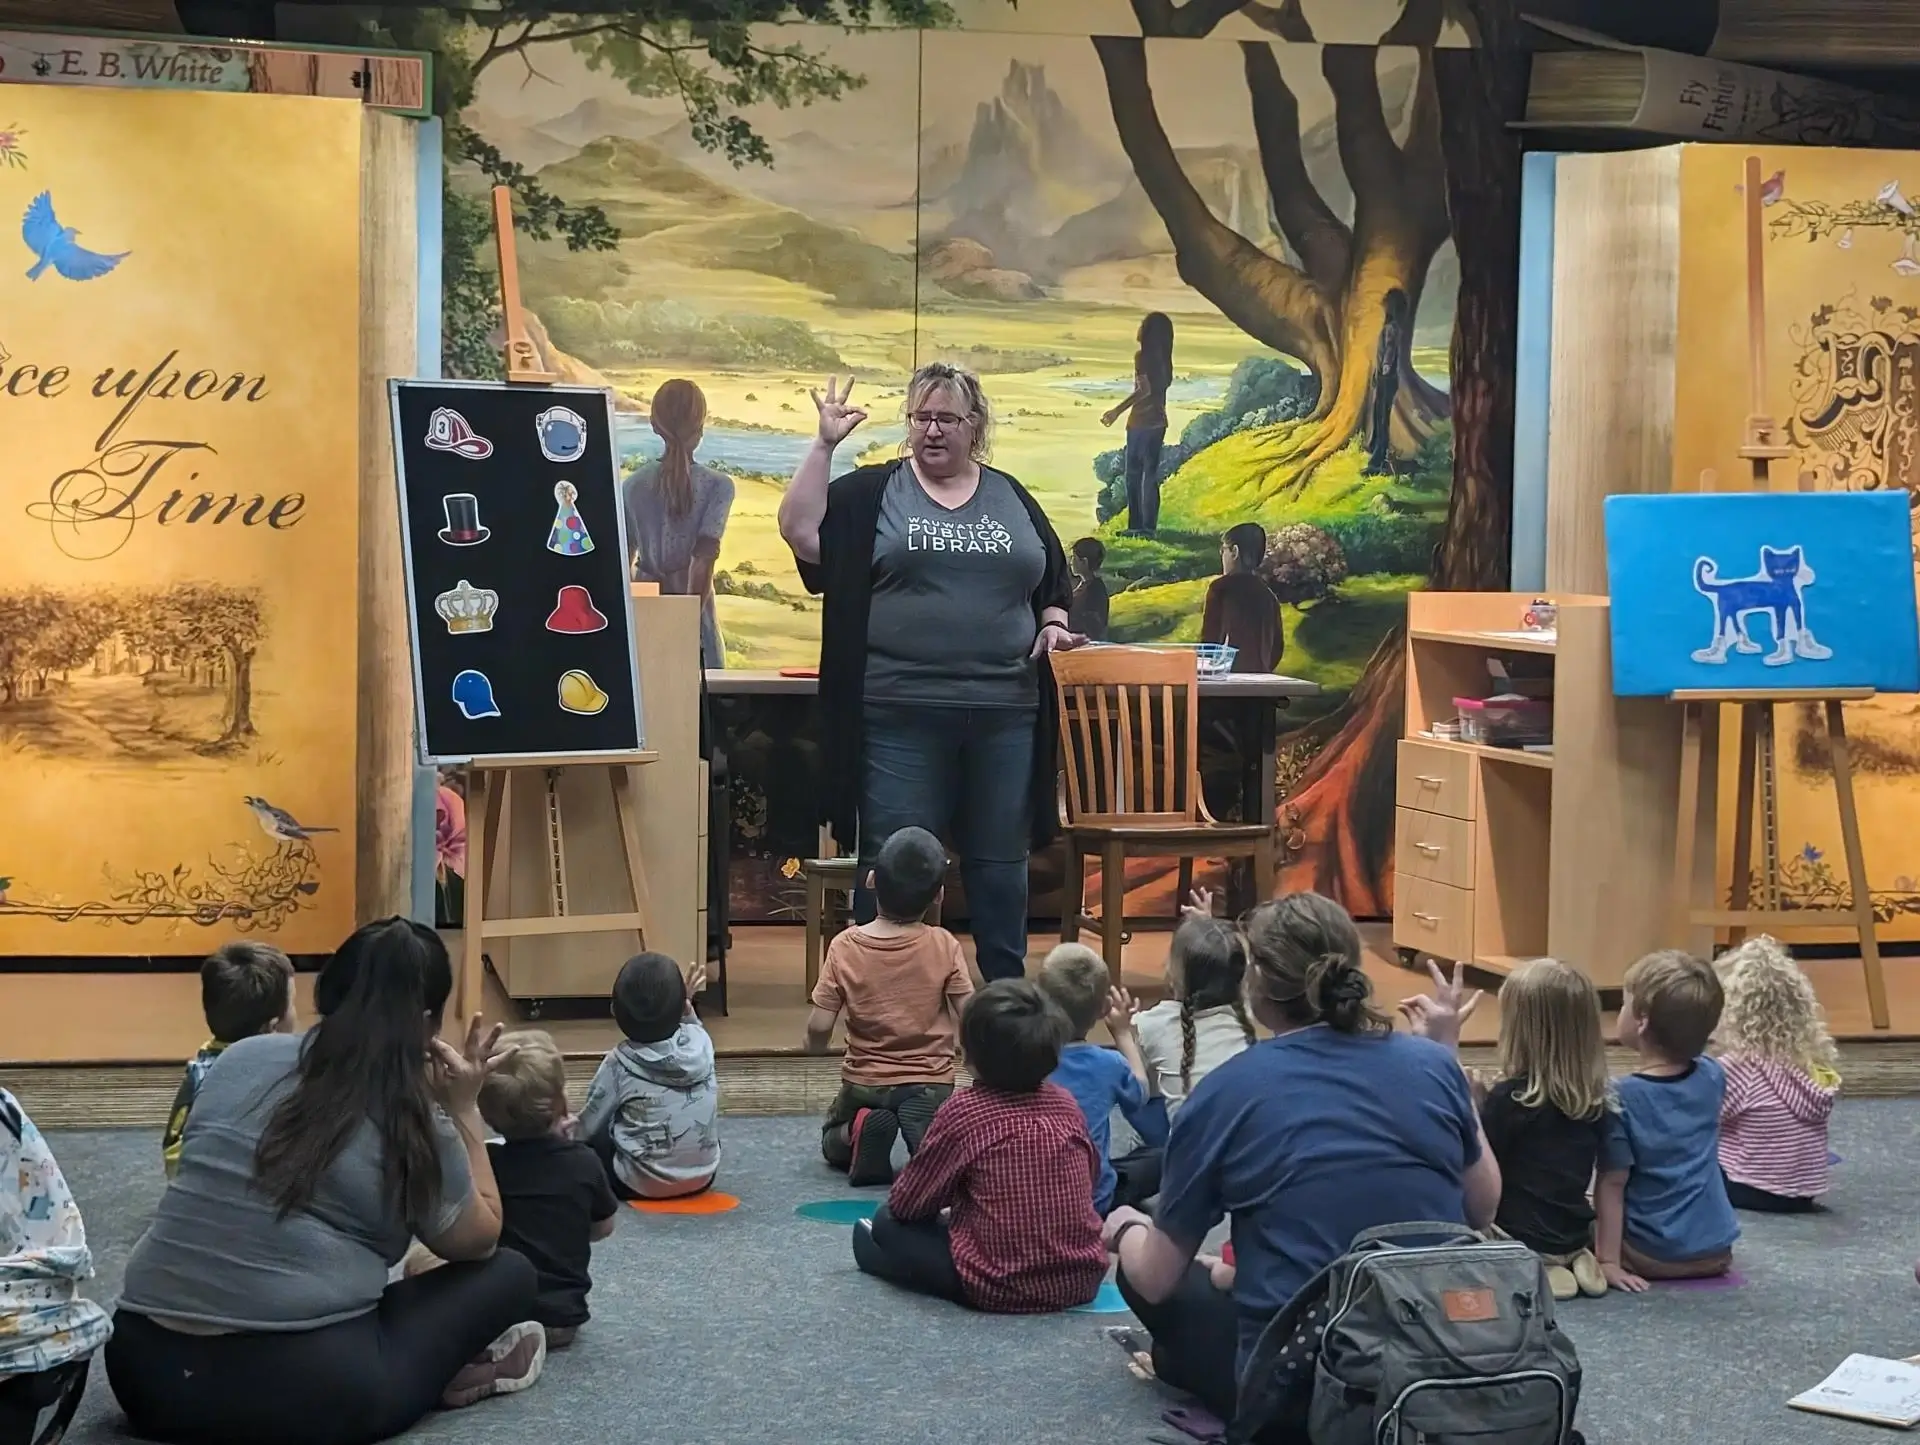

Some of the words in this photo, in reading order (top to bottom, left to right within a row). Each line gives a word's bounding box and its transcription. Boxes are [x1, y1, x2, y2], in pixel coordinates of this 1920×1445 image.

[58, 50, 89, 76] E.
[96, 51, 126, 79] B.
[130, 51, 225, 84] White
[1679, 78, 1708, 107] Fly
[92, 349, 271, 452] upon
[438, 421, 446, 434] 3
[25, 439, 306, 560] Time
[908, 516, 1006, 531] WAUWATOSA
[908, 523, 992, 541] PUBLIC
[908, 535, 1013, 554] LIBRARY
